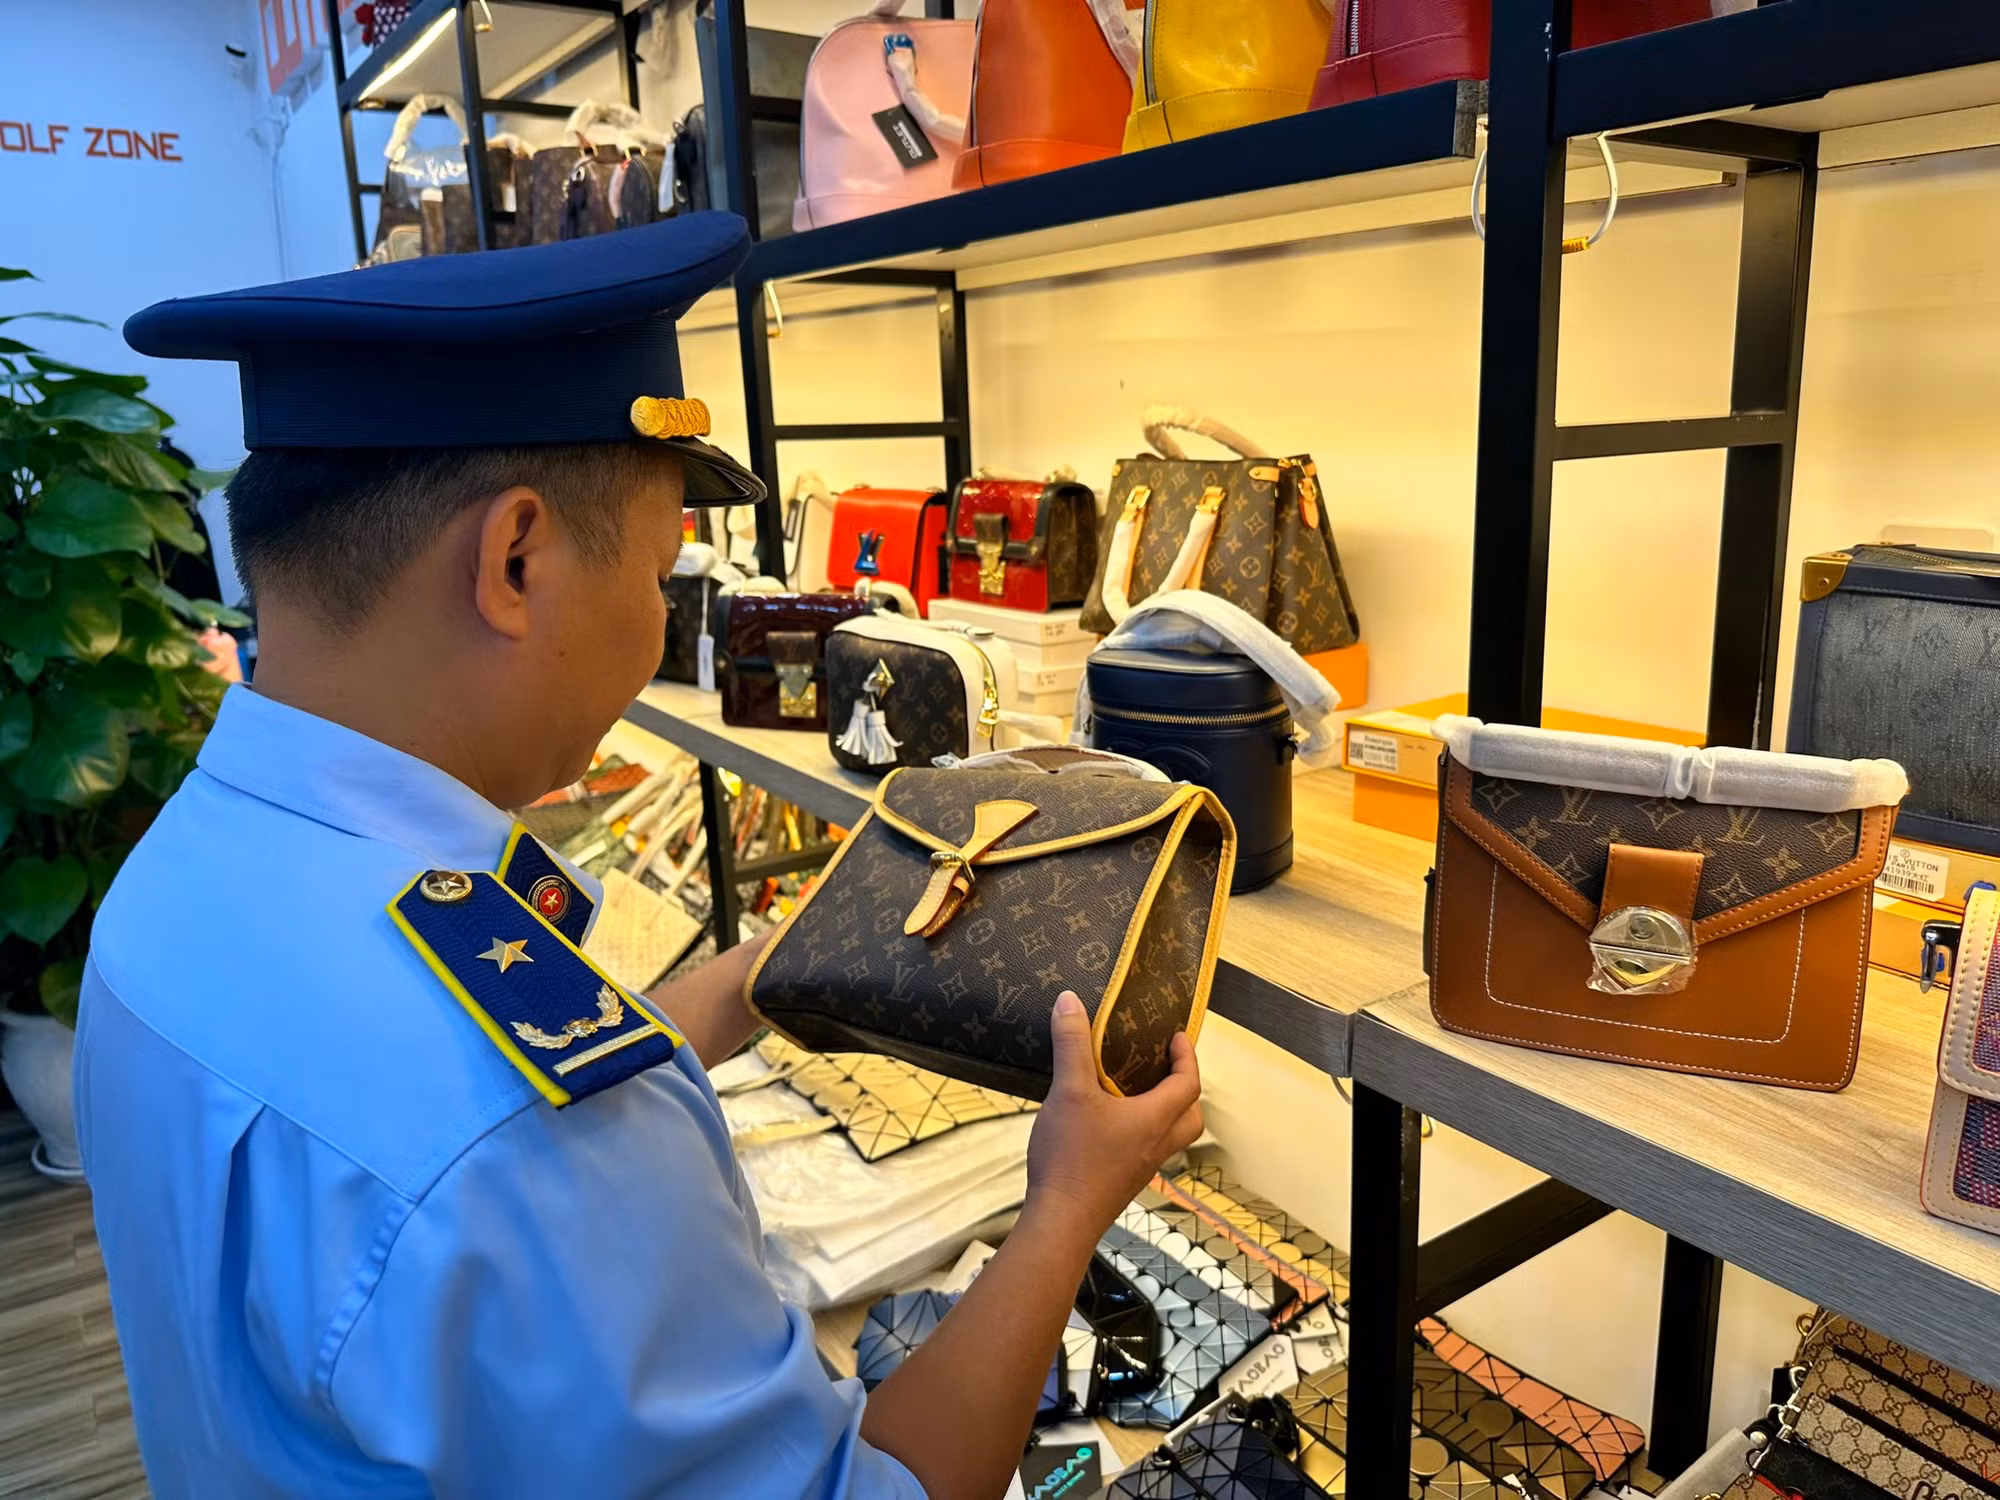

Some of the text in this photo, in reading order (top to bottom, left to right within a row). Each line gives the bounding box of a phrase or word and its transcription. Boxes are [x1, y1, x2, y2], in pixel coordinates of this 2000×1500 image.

[84, 127, 182, 162] ZONE
[1890, 860, 1915, 871] PARIS
[1904, 858, 1939, 872] VUTTON
